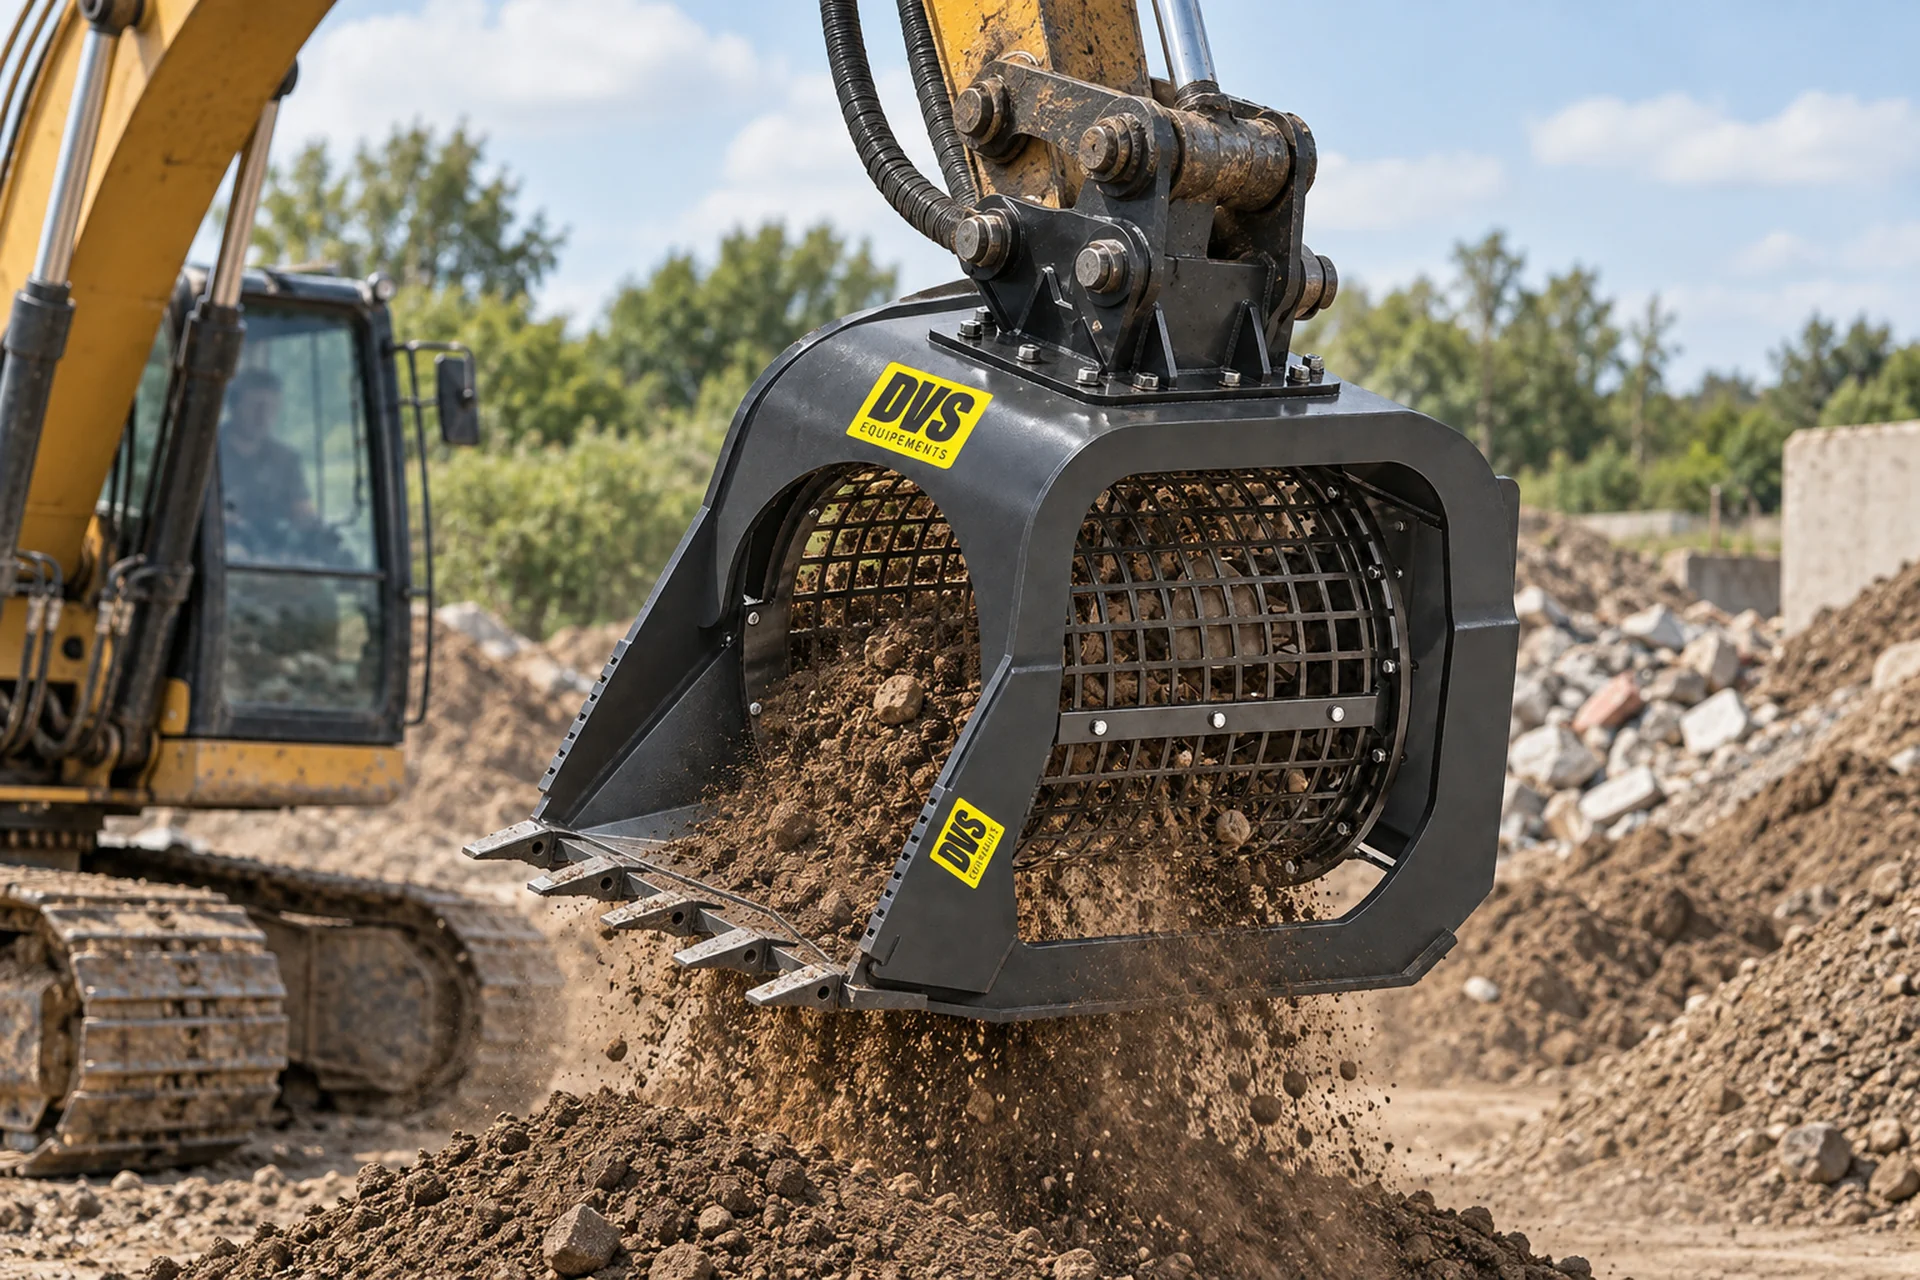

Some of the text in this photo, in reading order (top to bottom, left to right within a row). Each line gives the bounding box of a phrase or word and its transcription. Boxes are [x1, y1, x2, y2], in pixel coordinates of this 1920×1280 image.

[867, 371, 975, 442] DVS
[859, 421, 948, 460] EQUIPEMENTS
[937, 808, 987, 874] DVS
